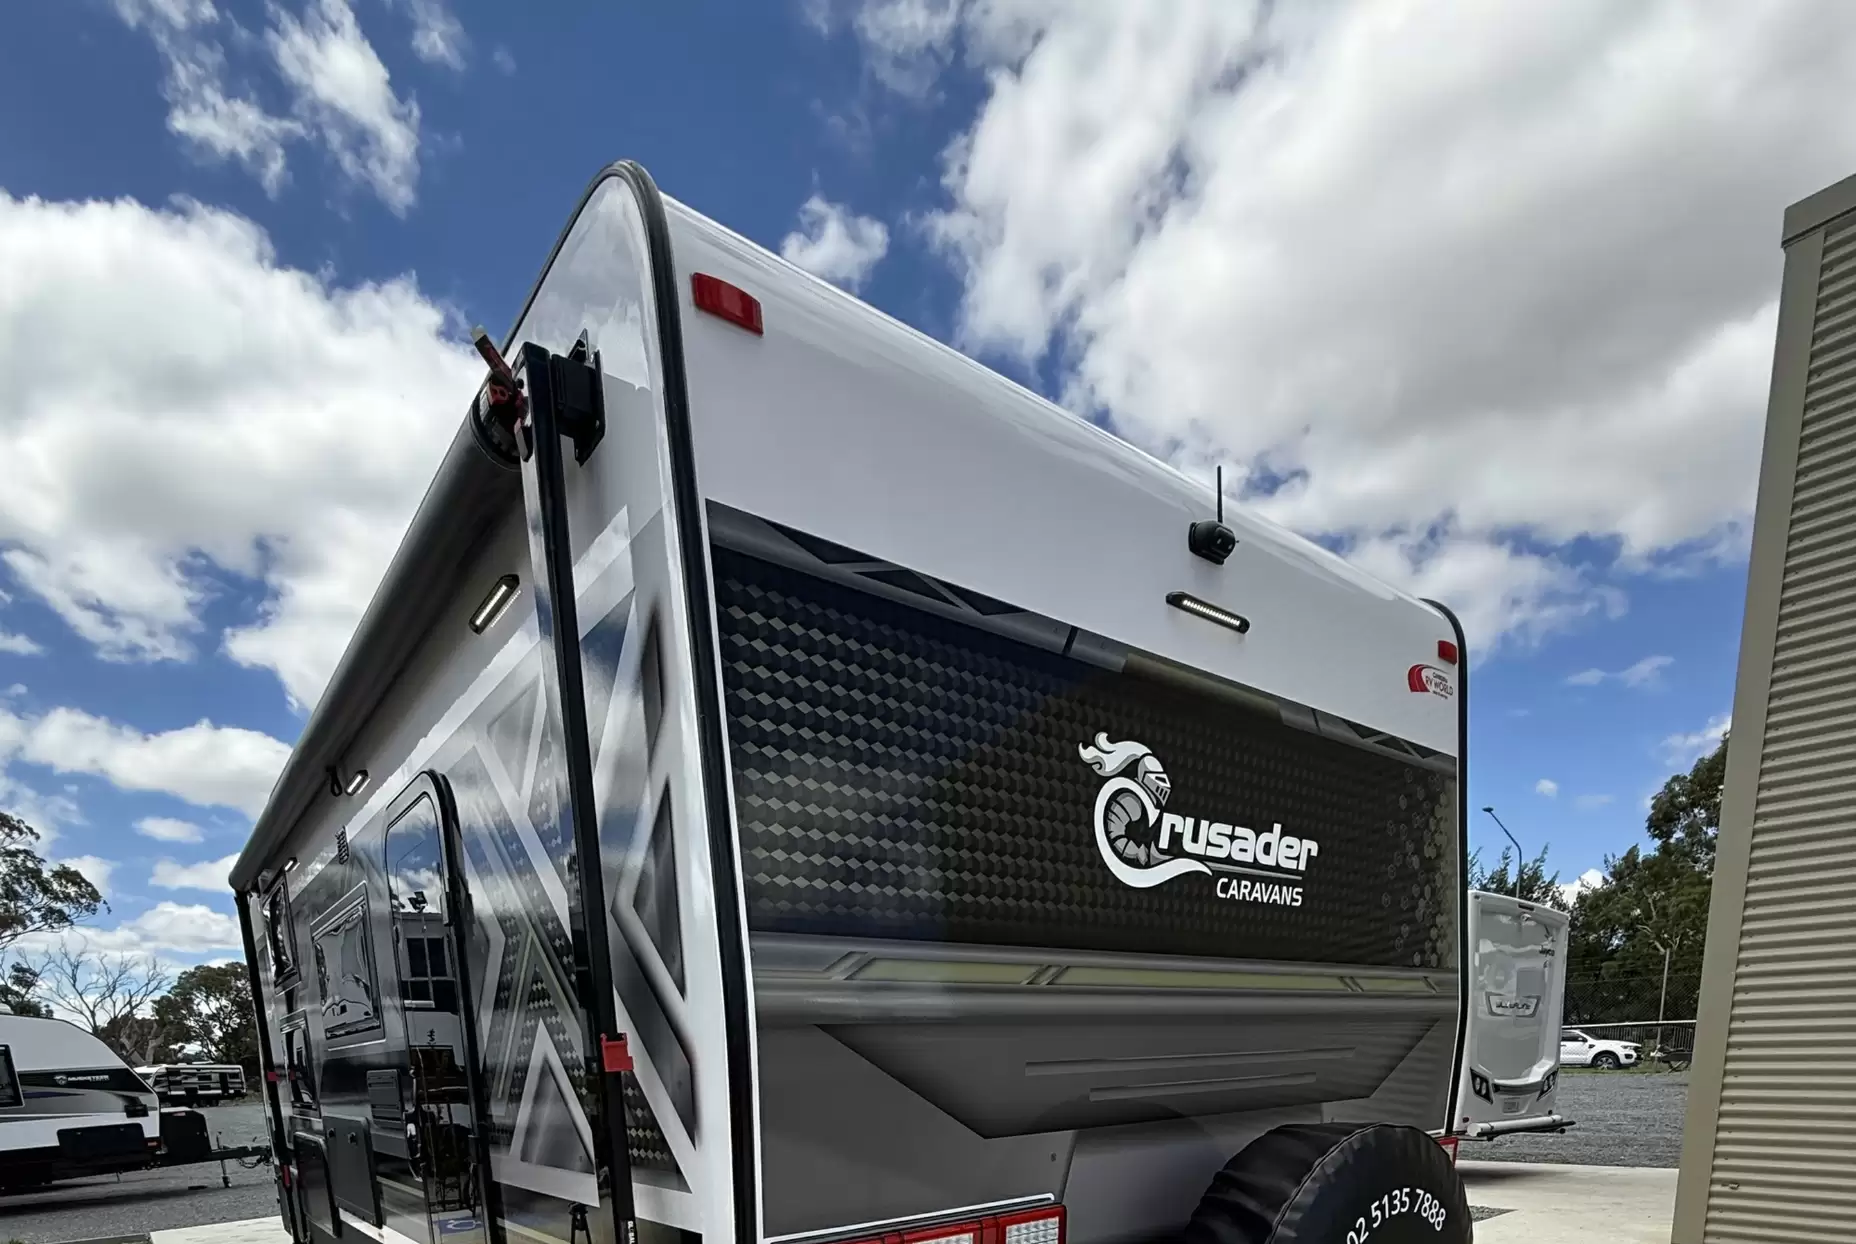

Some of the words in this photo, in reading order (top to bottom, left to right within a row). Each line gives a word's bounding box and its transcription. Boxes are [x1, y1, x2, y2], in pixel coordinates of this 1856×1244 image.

[1434, 680, 1453, 696] WORLD
[1094, 776, 1318, 888] Crusader
[1216, 877, 1303, 907] CARAVANS
[1371, 1187, 1410, 1228] 5135
[1413, 1188, 1446, 1231] 7888
